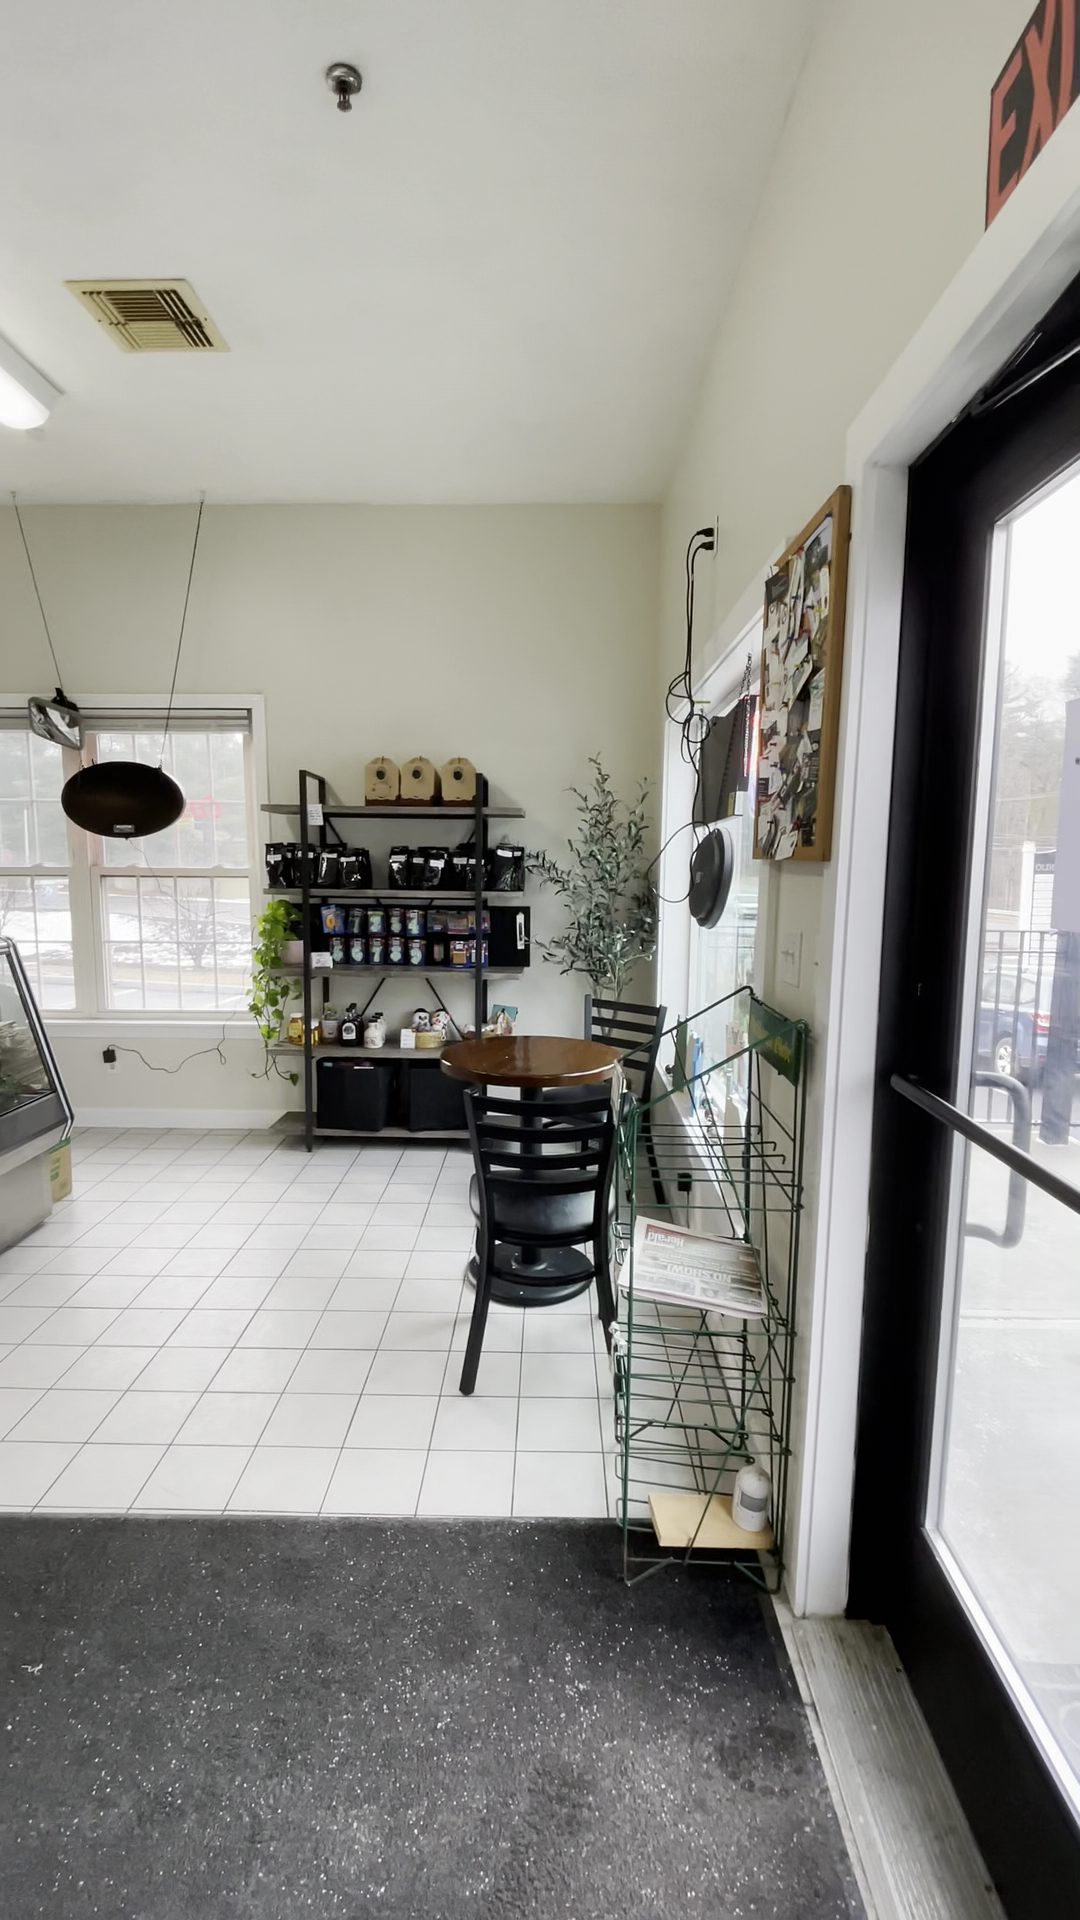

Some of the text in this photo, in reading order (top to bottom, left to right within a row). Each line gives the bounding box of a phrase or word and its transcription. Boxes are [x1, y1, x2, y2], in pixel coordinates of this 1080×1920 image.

[372, 946, 383, 962] 7
[410, 948, 422, 964] 9
[648, 1232, 685, 1247] Herald
